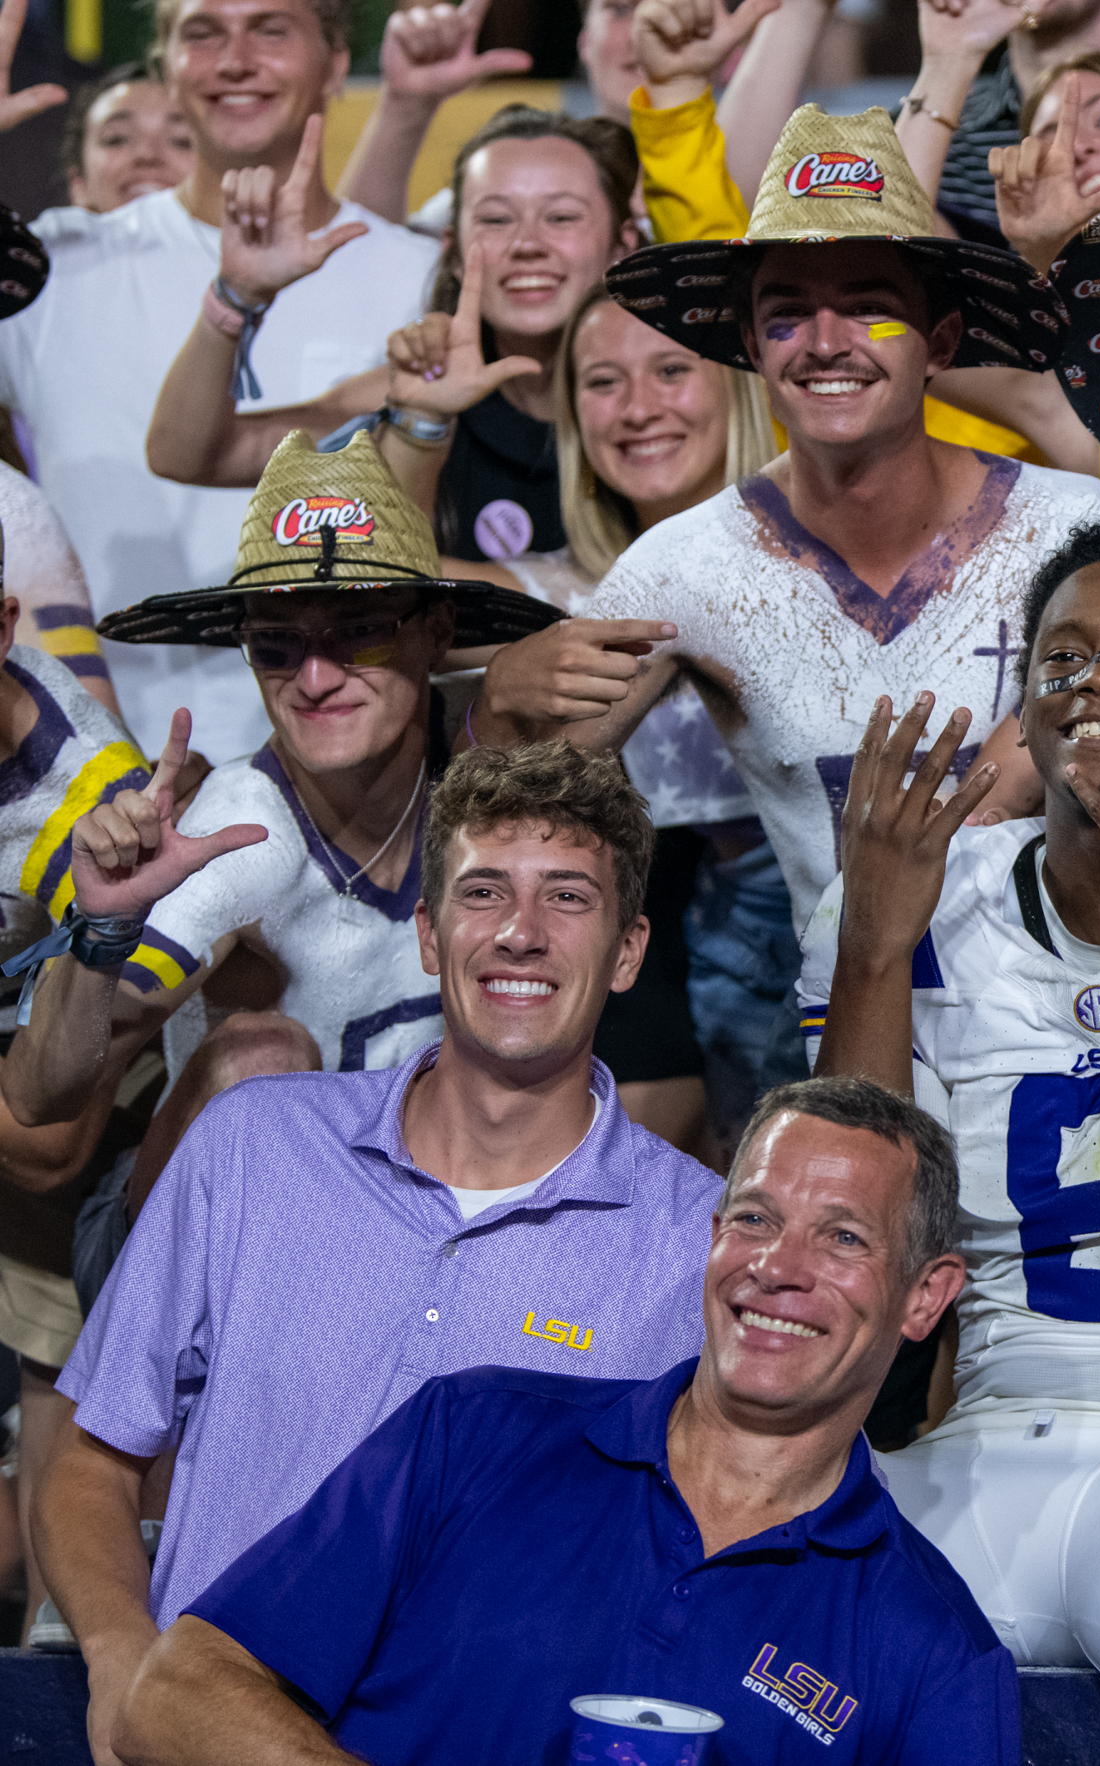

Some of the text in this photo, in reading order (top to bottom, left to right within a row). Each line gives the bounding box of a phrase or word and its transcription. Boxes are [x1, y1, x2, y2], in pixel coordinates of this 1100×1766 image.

[788, 153, 882, 197] Cane's
[821, 153, 856, 163] Raising
[276, 498, 372, 545] Cane's
[308, 499, 344, 509] Raising
[1038, 680, 1061, 695] RIP
[522, 1311, 594, 1351] LSU
[749, 1642, 858, 1732] LSU
[741, 1674, 836, 1746] GOLDEN GIRLS
